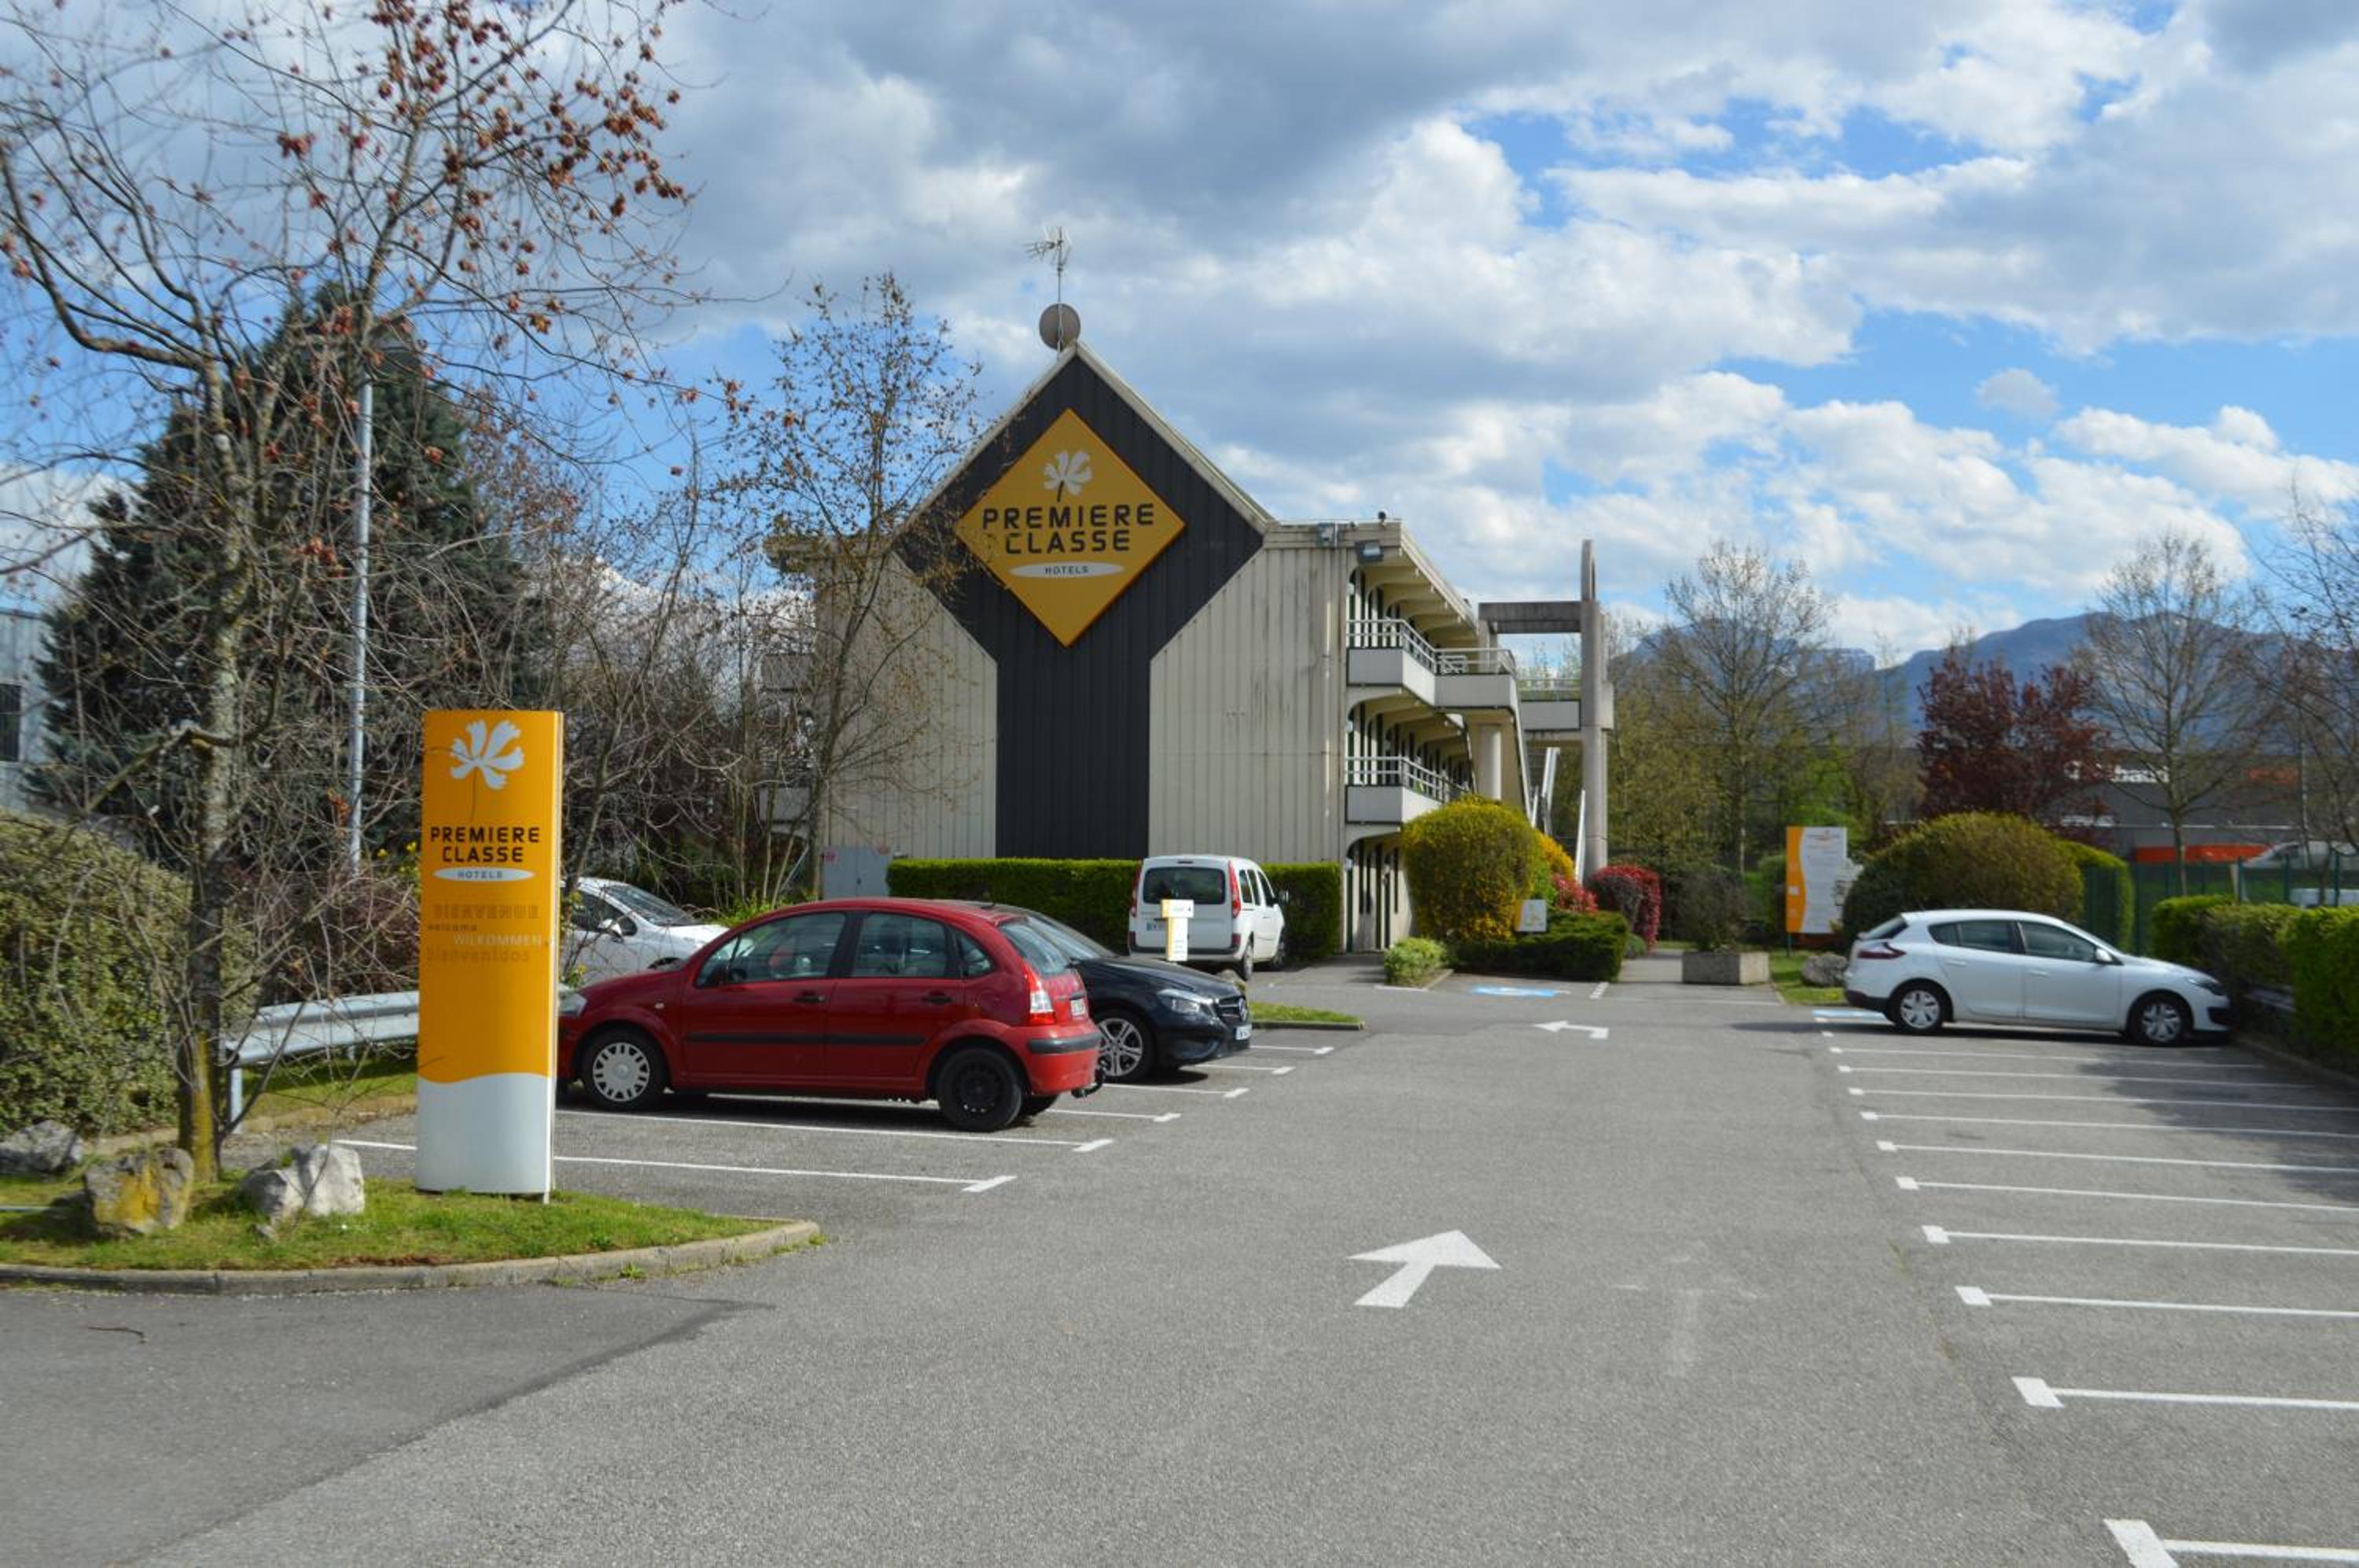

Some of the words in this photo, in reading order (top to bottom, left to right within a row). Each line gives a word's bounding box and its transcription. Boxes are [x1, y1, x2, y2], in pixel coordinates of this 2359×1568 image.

[982, 503, 1154, 529] PREMIERE
[1006, 530, 1131, 554] CLASSE
[1044, 565, 1089, 575] HOTELS
[431, 826, 540, 843] PREMIERE
[442, 846, 524, 863] CLASSE
[458, 870, 504, 879] HOTELS
